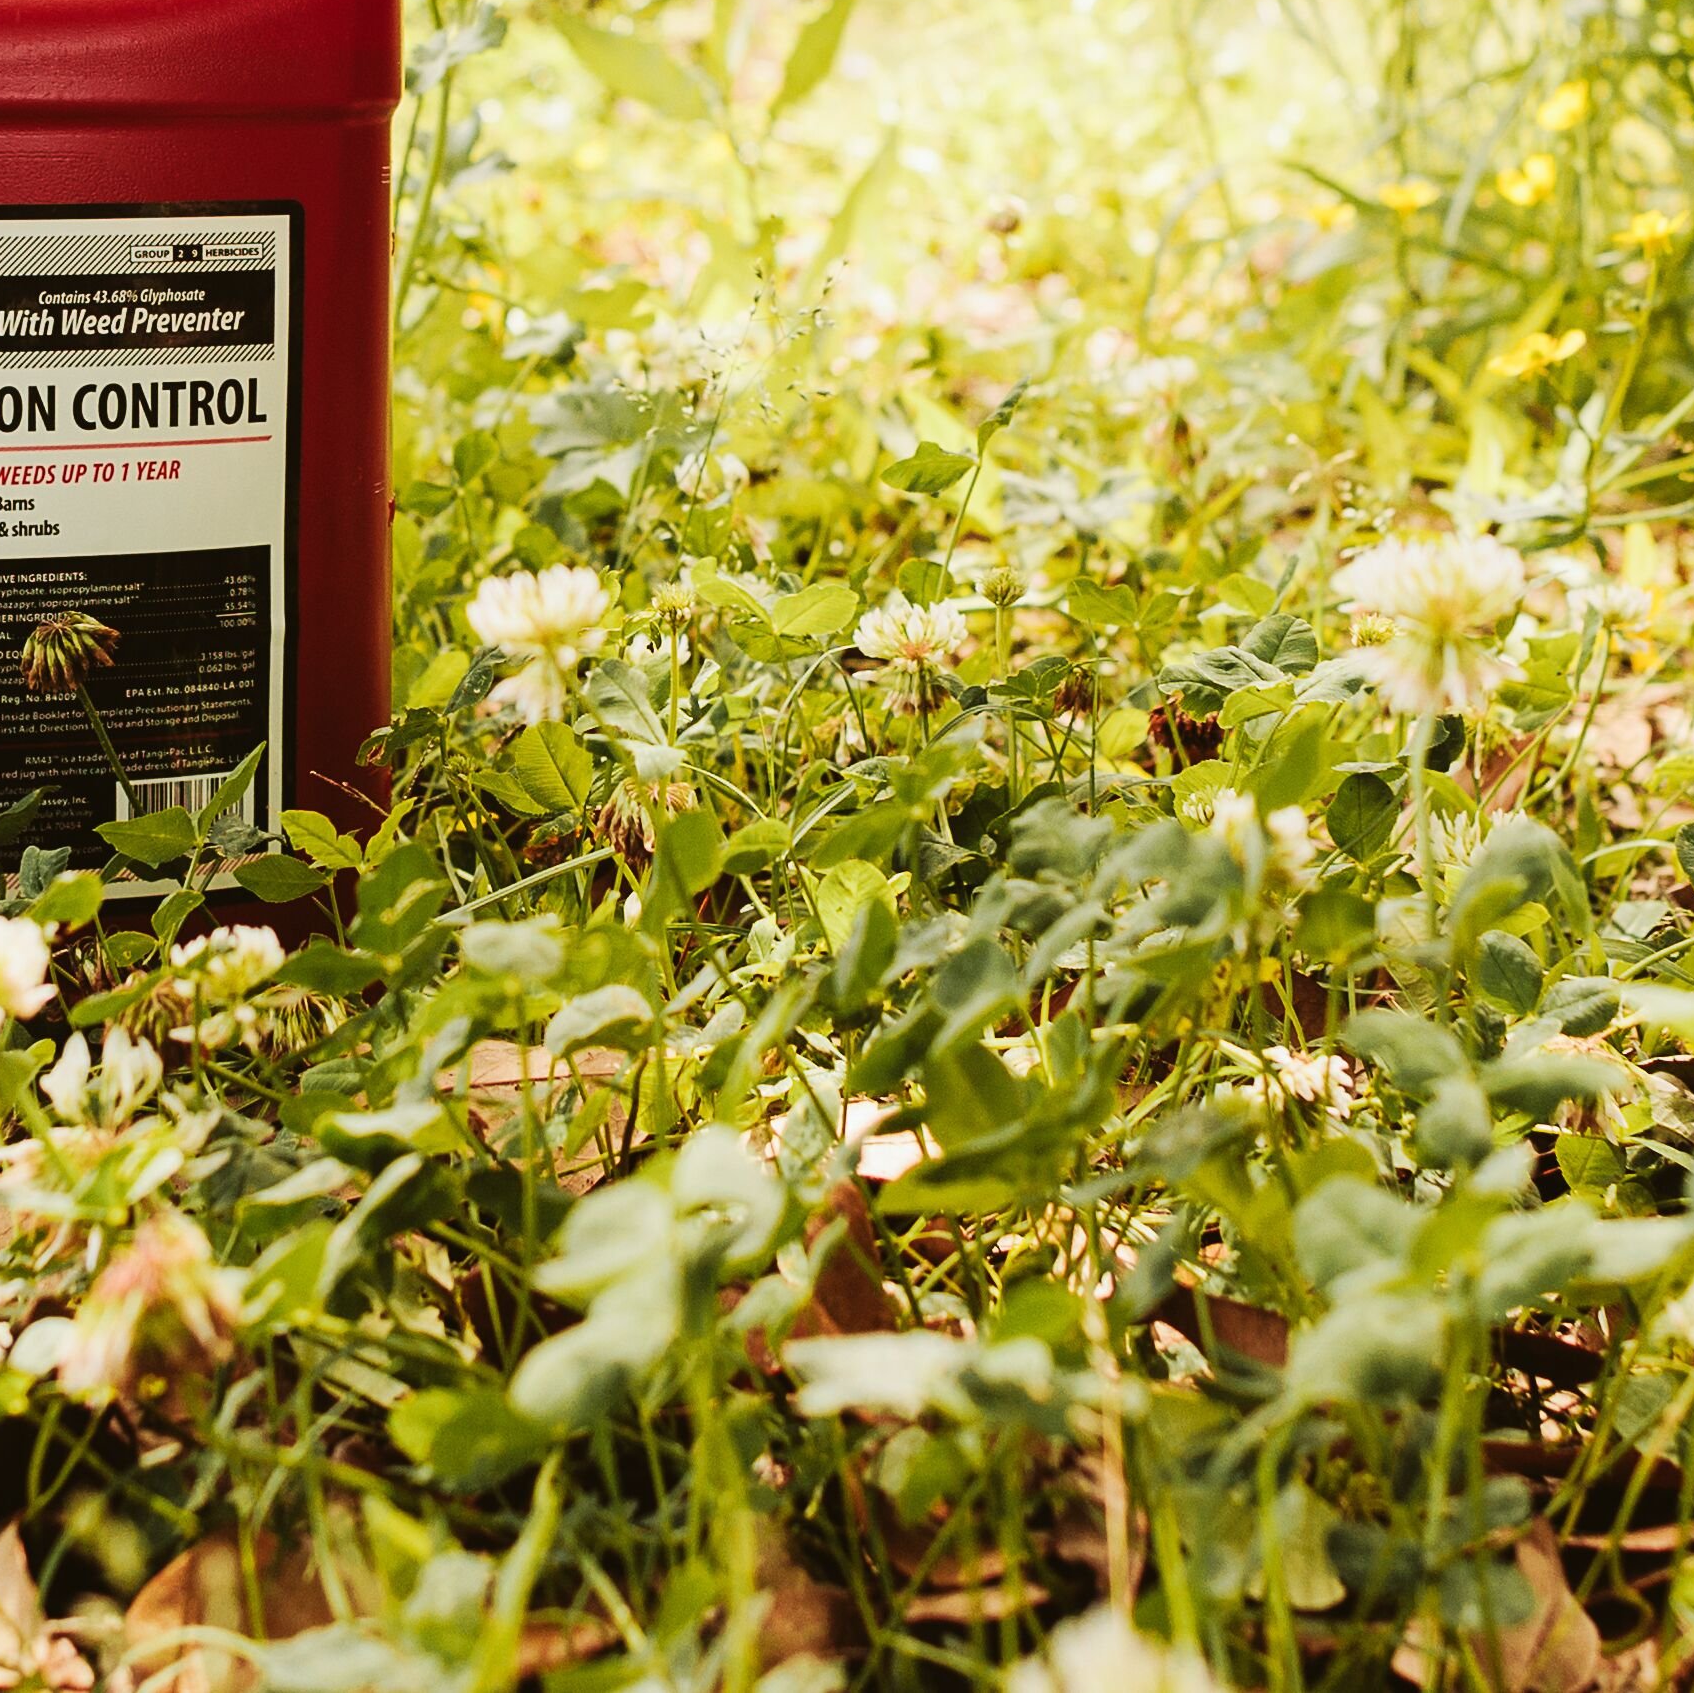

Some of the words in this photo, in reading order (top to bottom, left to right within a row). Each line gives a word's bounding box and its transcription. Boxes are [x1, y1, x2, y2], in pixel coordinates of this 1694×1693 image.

[134, 249, 170, 259] GROUP
[178, 249, 184, 258] 2
[192, 248, 198, 257] 9
[205, 247, 260, 258] HERBICIDES
[38, 290, 91, 305] Contains
[92, 289, 138, 304] 43.68%
[140, 287, 206, 306] Glyphosate
[61, 307, 128, 335] Weed
[131, 306, 245, 334] Preventer
[72, 377, 267, 431] CONTROL
[62, 463, 87, 484] UP
[93, 462, 114, 482] TO
[122, 462, 129, 481] 1
[136, 460, 181, 480] YEAR
[11, 519, 59, 537] shrubs
[18, 571, 87, 583] INGREDIENTS:
[49, 584, 122, 595] isopropylamine
[39, 597, 112, 609] isopropylamine
[126, 689, 144, 698] EPA
[166, 687, 182, 695] No.
[1, 695, 23, 705] Reg.
[26, 694, 43, 702] No.
[1, 712, 30, 721] Inside
[33, 710, 69, 720] Booklet
[126, 718, 143, 727] and
[182, 714, 199, 724] and
[2, 769, 18, 778] red
[20, 769, 36, 780] jug
[38, 768, 59, 777] with
